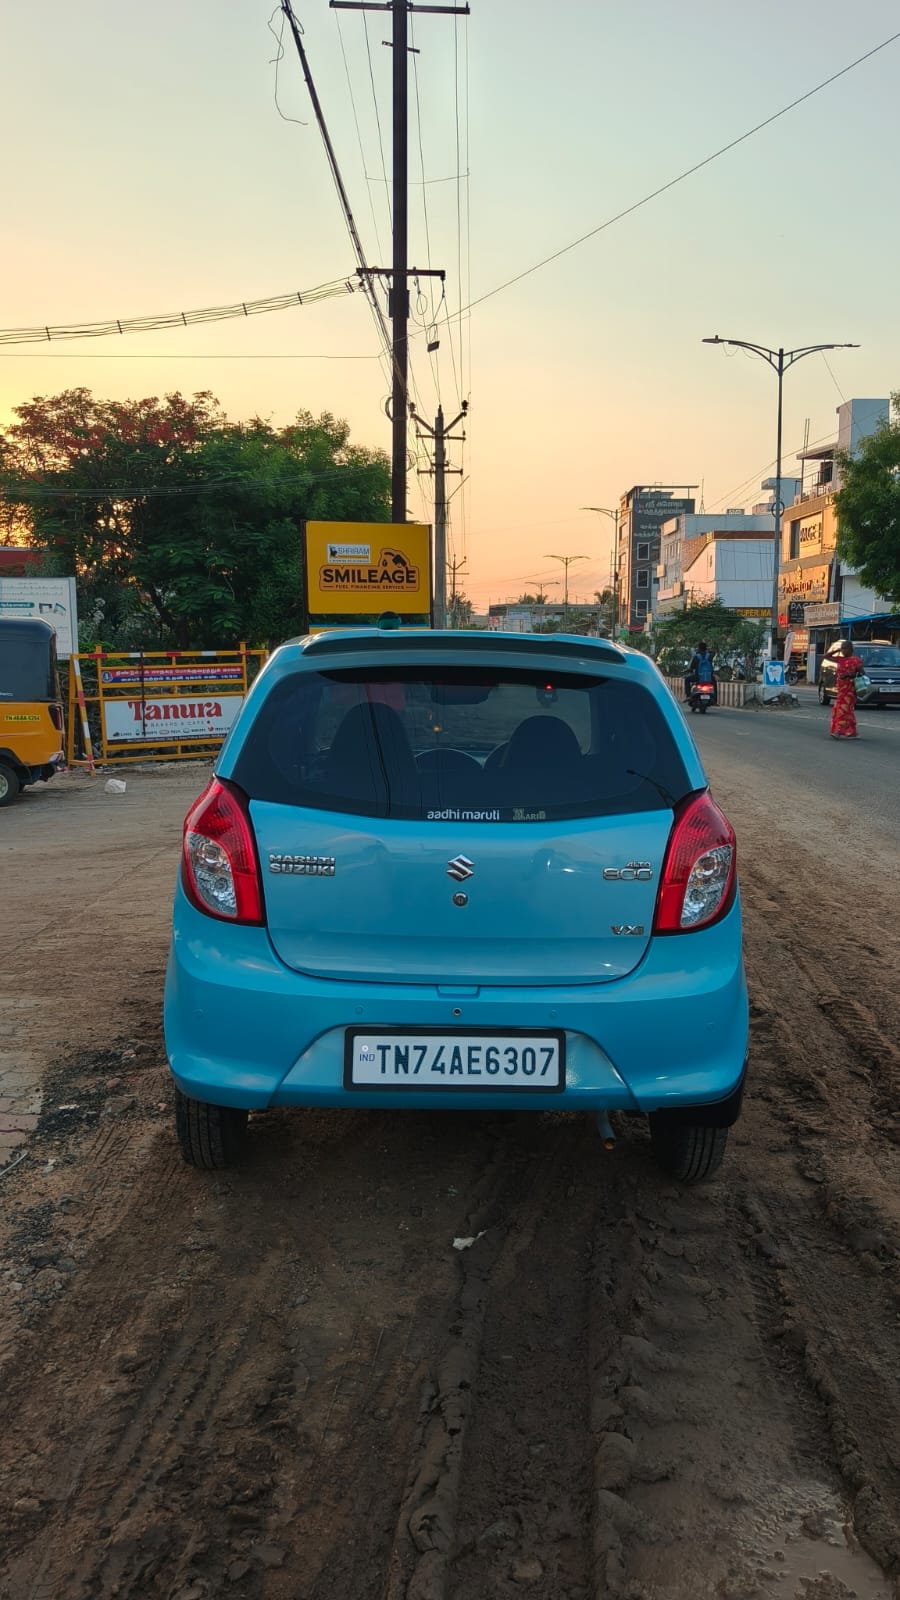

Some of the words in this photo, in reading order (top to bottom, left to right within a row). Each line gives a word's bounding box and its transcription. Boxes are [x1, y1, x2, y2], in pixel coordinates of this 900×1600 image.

[322, 568, 417, 584] SMILEAGE
[127, 701, 223, 721] Tanura
[427, 808, 460, 820] aadhi
[461, 809, 500, 821] maruti
[269, 854, 336, 865] MARUTI
[269, 863, 336, 876] SUZUKI
[603, 867, 653, 881] 800
[359, 1053, 376, 1062] IND
[376, 1044, 555, 1076] TN74AE6307
